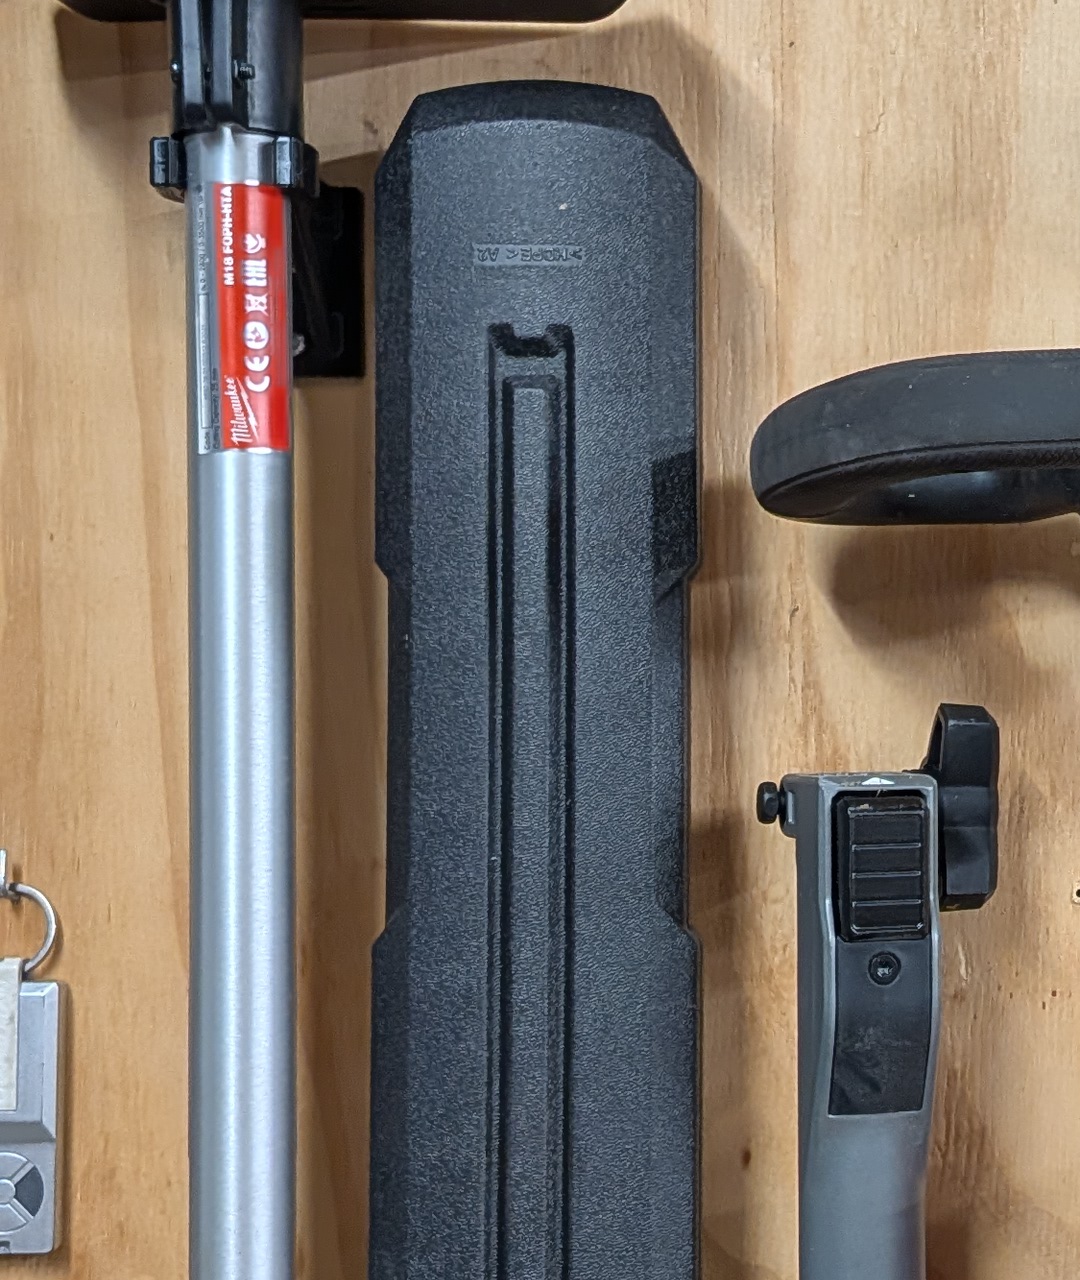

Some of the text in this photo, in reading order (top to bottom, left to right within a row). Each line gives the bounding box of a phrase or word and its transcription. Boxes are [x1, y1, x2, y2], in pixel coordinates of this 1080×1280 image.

[220, 185, 235, 286] M18 FOPH-HTA
[244, 354, 271, 393] CE
[223, 374, 254, 447] Milwaukee
